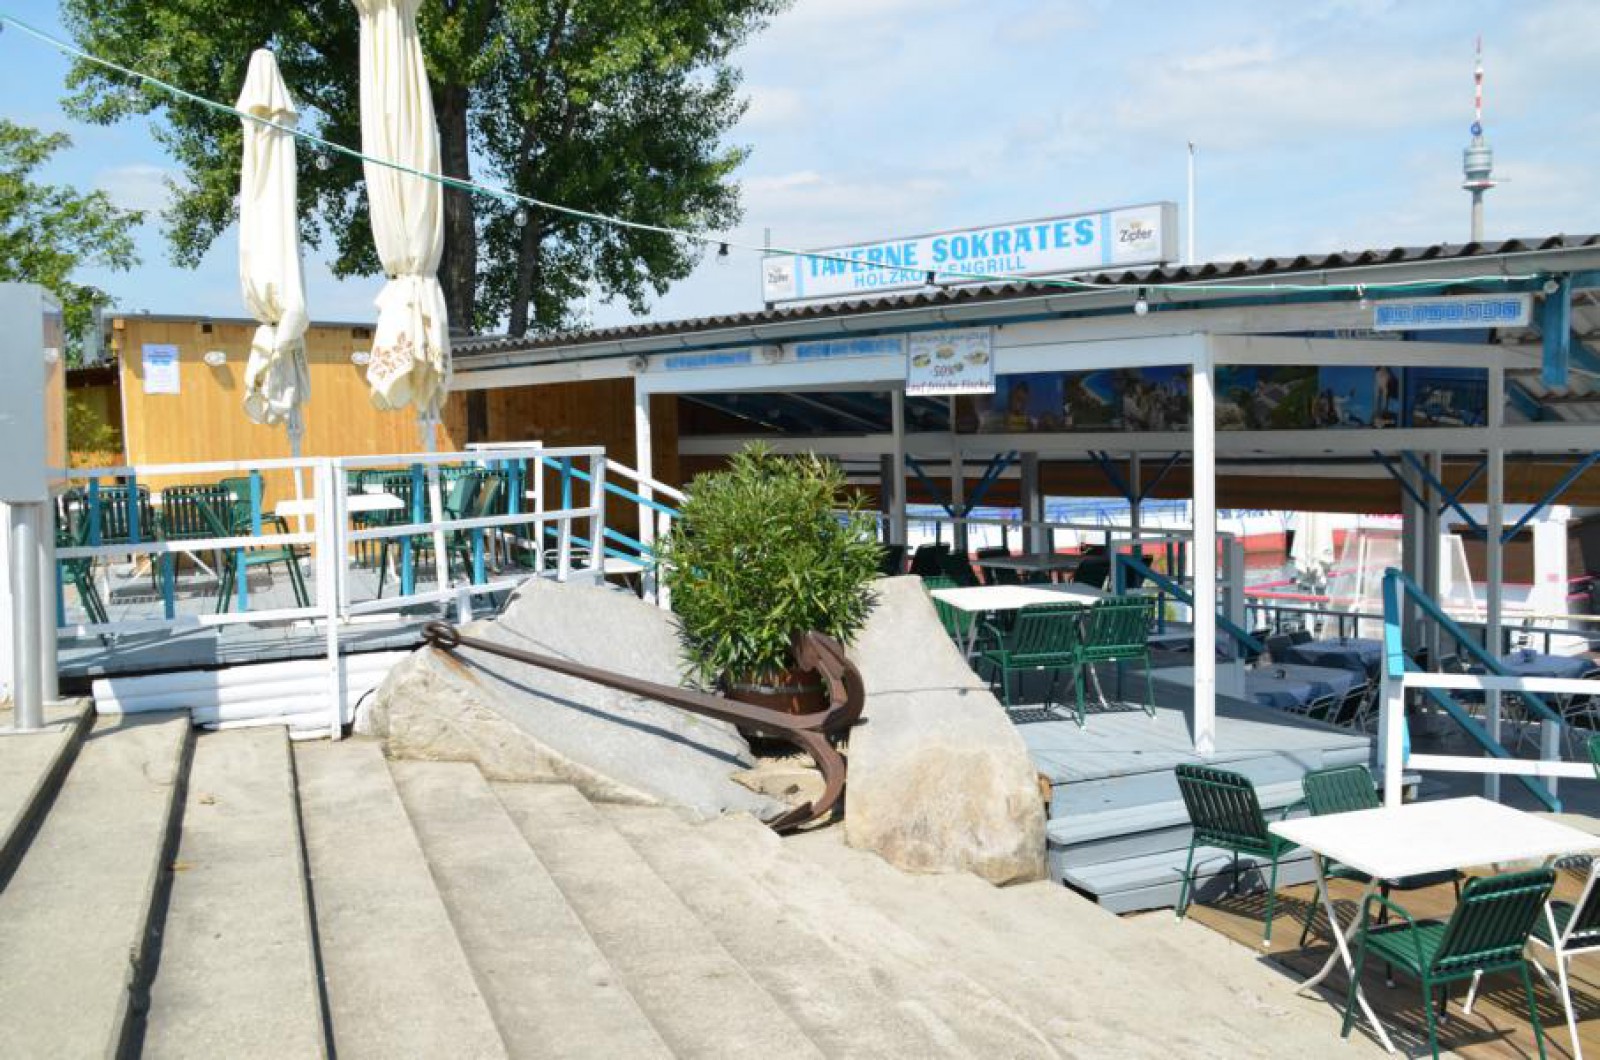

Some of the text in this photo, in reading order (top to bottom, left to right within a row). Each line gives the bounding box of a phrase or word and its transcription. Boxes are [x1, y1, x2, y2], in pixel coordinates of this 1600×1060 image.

[807, 218, 1094, 278] TAVERNE SOKRATES
[1119, 227, 1152, 244] Zipfer
[854, 256, 1025, 287] HOLZKOENGRILL
